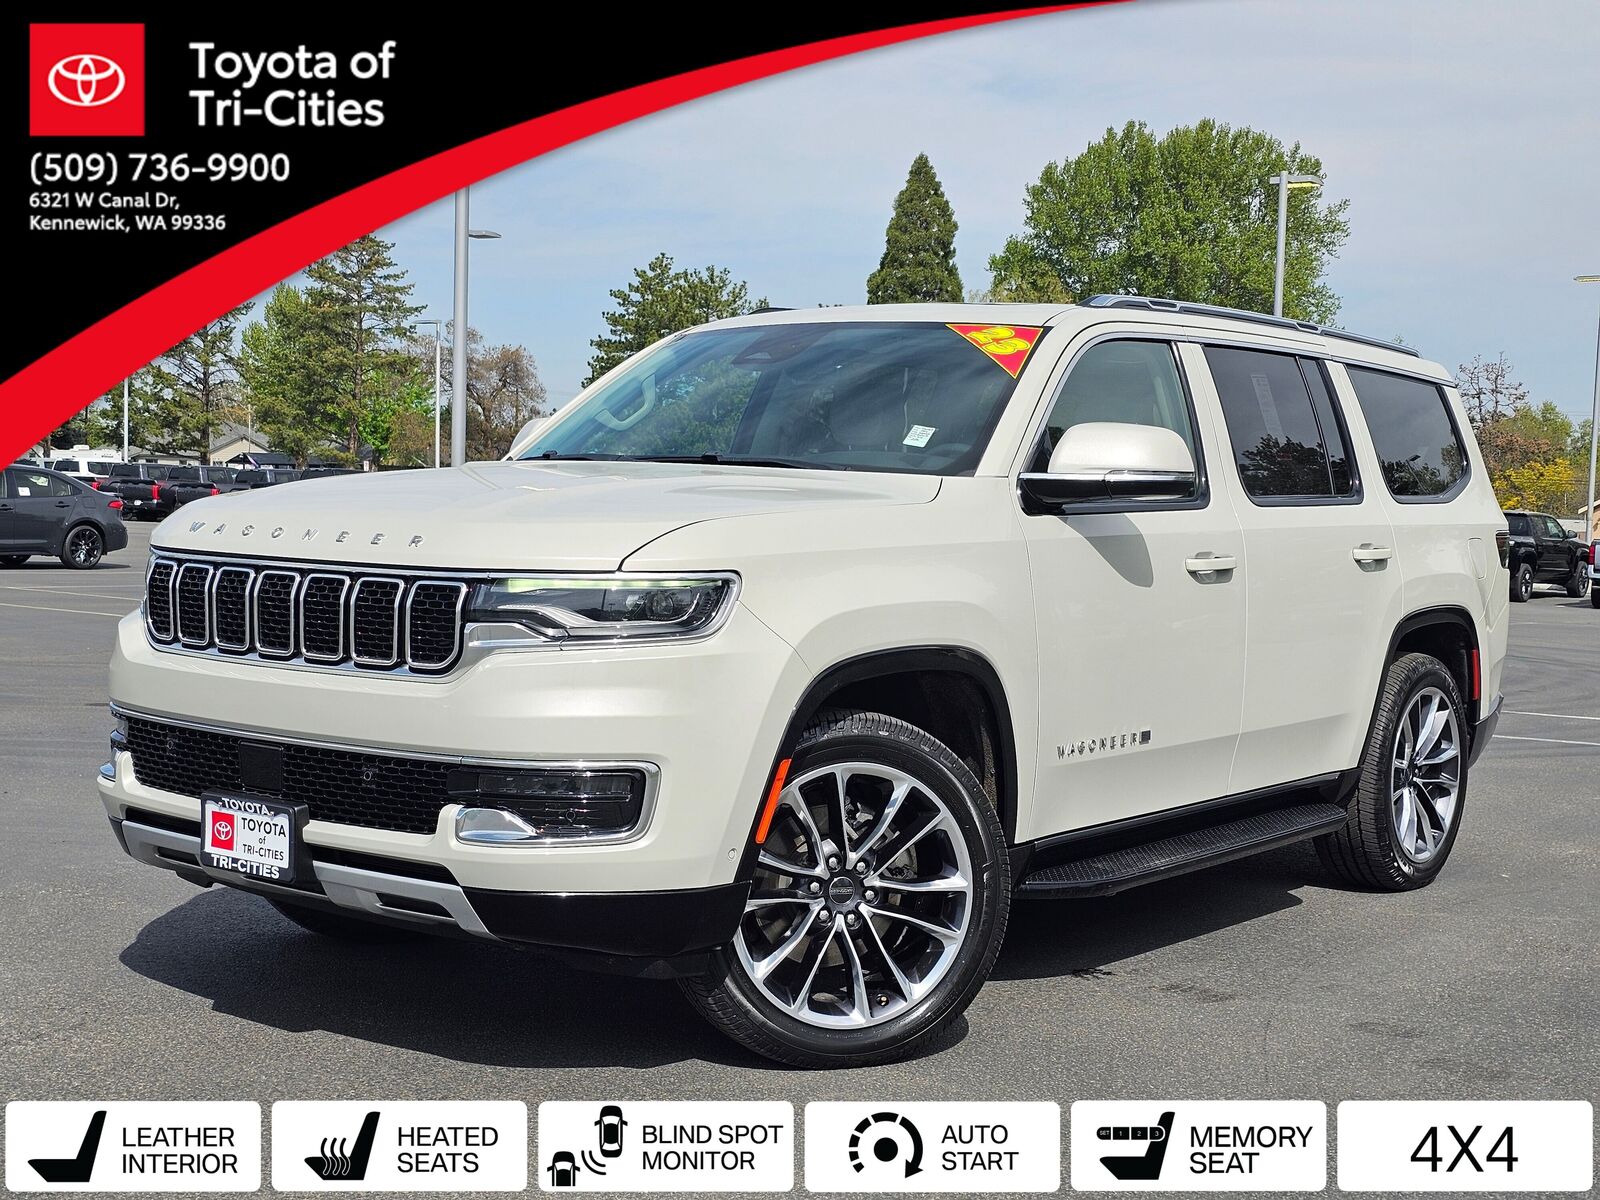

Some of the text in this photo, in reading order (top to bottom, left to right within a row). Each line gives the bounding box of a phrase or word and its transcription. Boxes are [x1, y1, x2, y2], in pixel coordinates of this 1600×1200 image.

[189, 521, 424, 548] WAGONEER
[1056, 732, 1138, 760] WAGONEER
[221, 797, 272, 816] TOYOTA
[241, 817, 287, 838] TOYOTA
[258, 836, 267, 845] of
[242, 844, 284, 861] TRI-CITIES
[211, 854, 280, 879] TRI-CITIES
